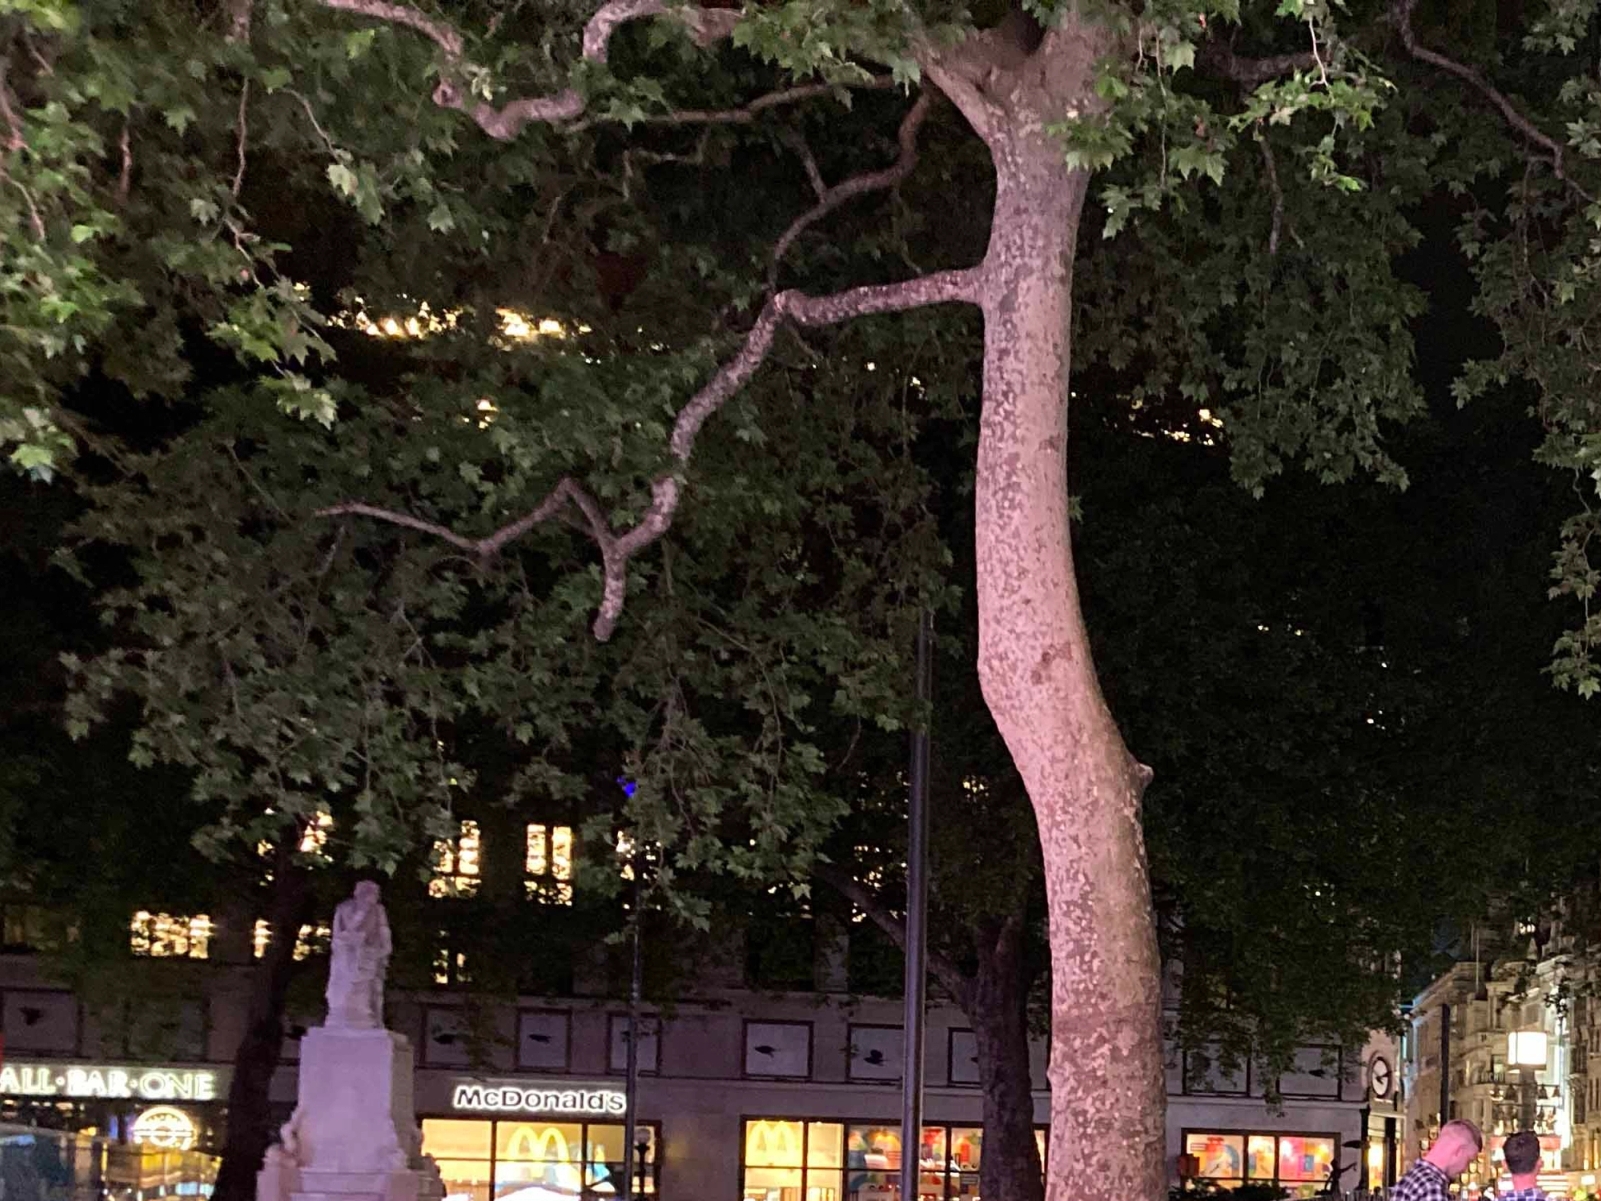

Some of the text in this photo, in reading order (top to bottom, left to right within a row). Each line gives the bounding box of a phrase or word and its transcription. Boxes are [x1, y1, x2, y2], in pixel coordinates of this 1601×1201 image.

[0, 1066, 215, 1100] ALL BAR ONE
[454, 1086, 626, 1113] McDonald's
